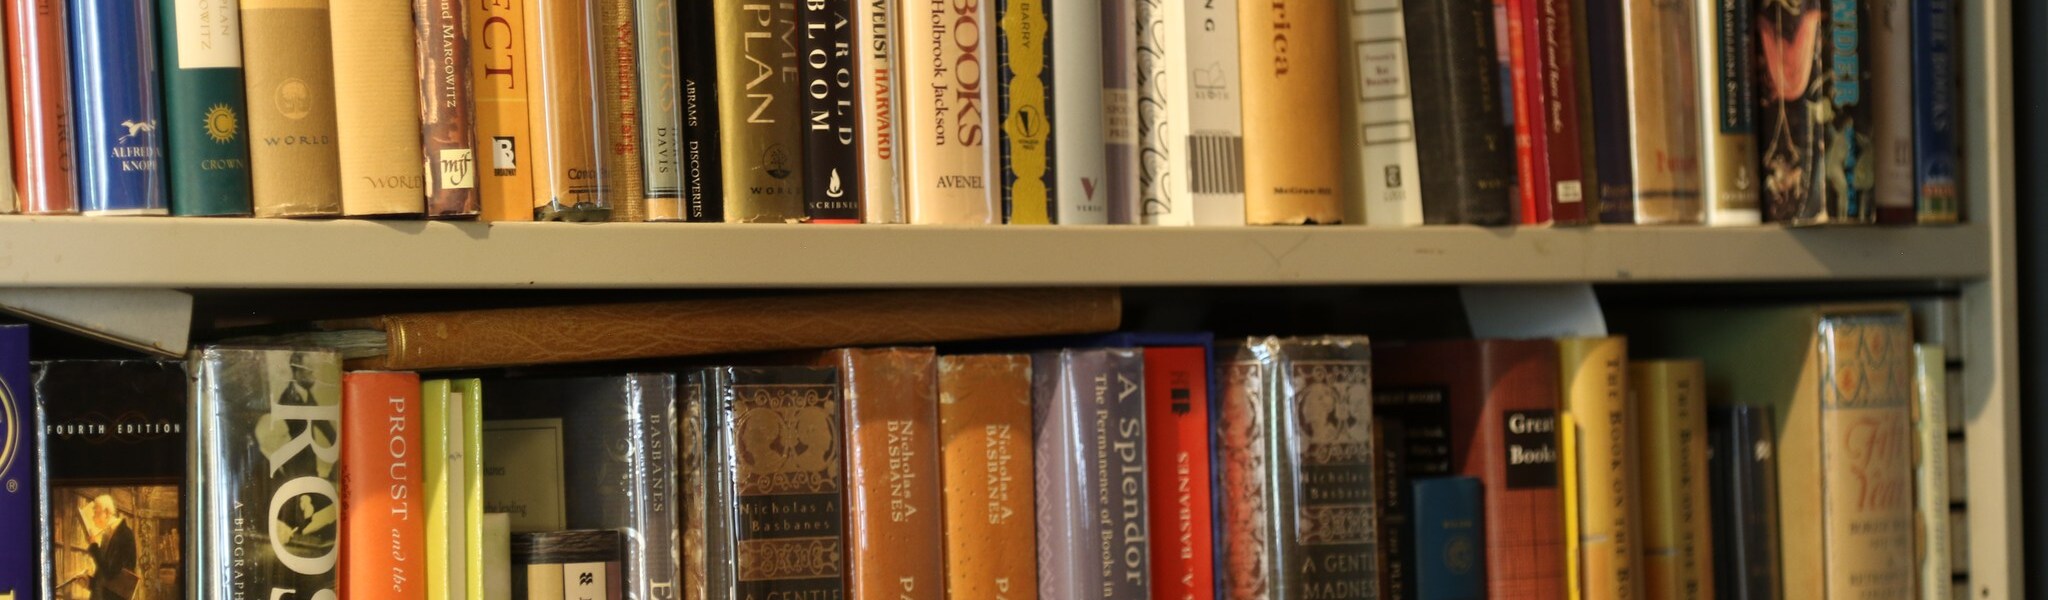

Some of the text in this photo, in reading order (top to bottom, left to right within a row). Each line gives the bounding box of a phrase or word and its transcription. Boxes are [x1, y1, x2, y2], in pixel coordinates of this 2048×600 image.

[743, 4, 776, 124] PLAN
[1020, 2, 1030, 49] BARRY
[442, 24, 457, 108] MARCOWITZ
[615, 21, 635, 156] William Targ
[806, 0, 831, 131] BLOOM
[931, 0, 949, 146] Holbrook Jackson
[263, 135, 330, 147] WORLD
[657, 127, 669, 174] DAVIS
[686, 79, 702, 219] ABRAMS DISCOVERIES
[874, 68, 893, 161] HARVARD
[201, 159, 244, 171] CROWN
[363, 176, 421, 190] WORLD
[936, 176, 985, 189] AVENEL
[47, 423, 181, 434] FOURTH EDITION
[901, 420, 916, 499] Nicholas
[998, 424, 1013, 502] Nicholas
[1508, 413, 1554, 434] Great
[1609, 410, 1624, 472] BOOK
[389, 396, 408, 593] PROUST and the
[651, 414, 663, 513] BASBANES
[887, 420, 904, 523] BASBANES
[985, 425, 1000, 525] BASBANES
[1094, 373, 1116, 598] The Permanence of Books in
[1114, 374, 1145, 586] A Splendor
[233, 500, 244, 510] A
[740, 501, 817, 516] Nicholas
[751, 520, 831, 533] Basbanes
[1176, 452, 1194, 560] BASBANES
[1302, 556, 1317, 574] A
